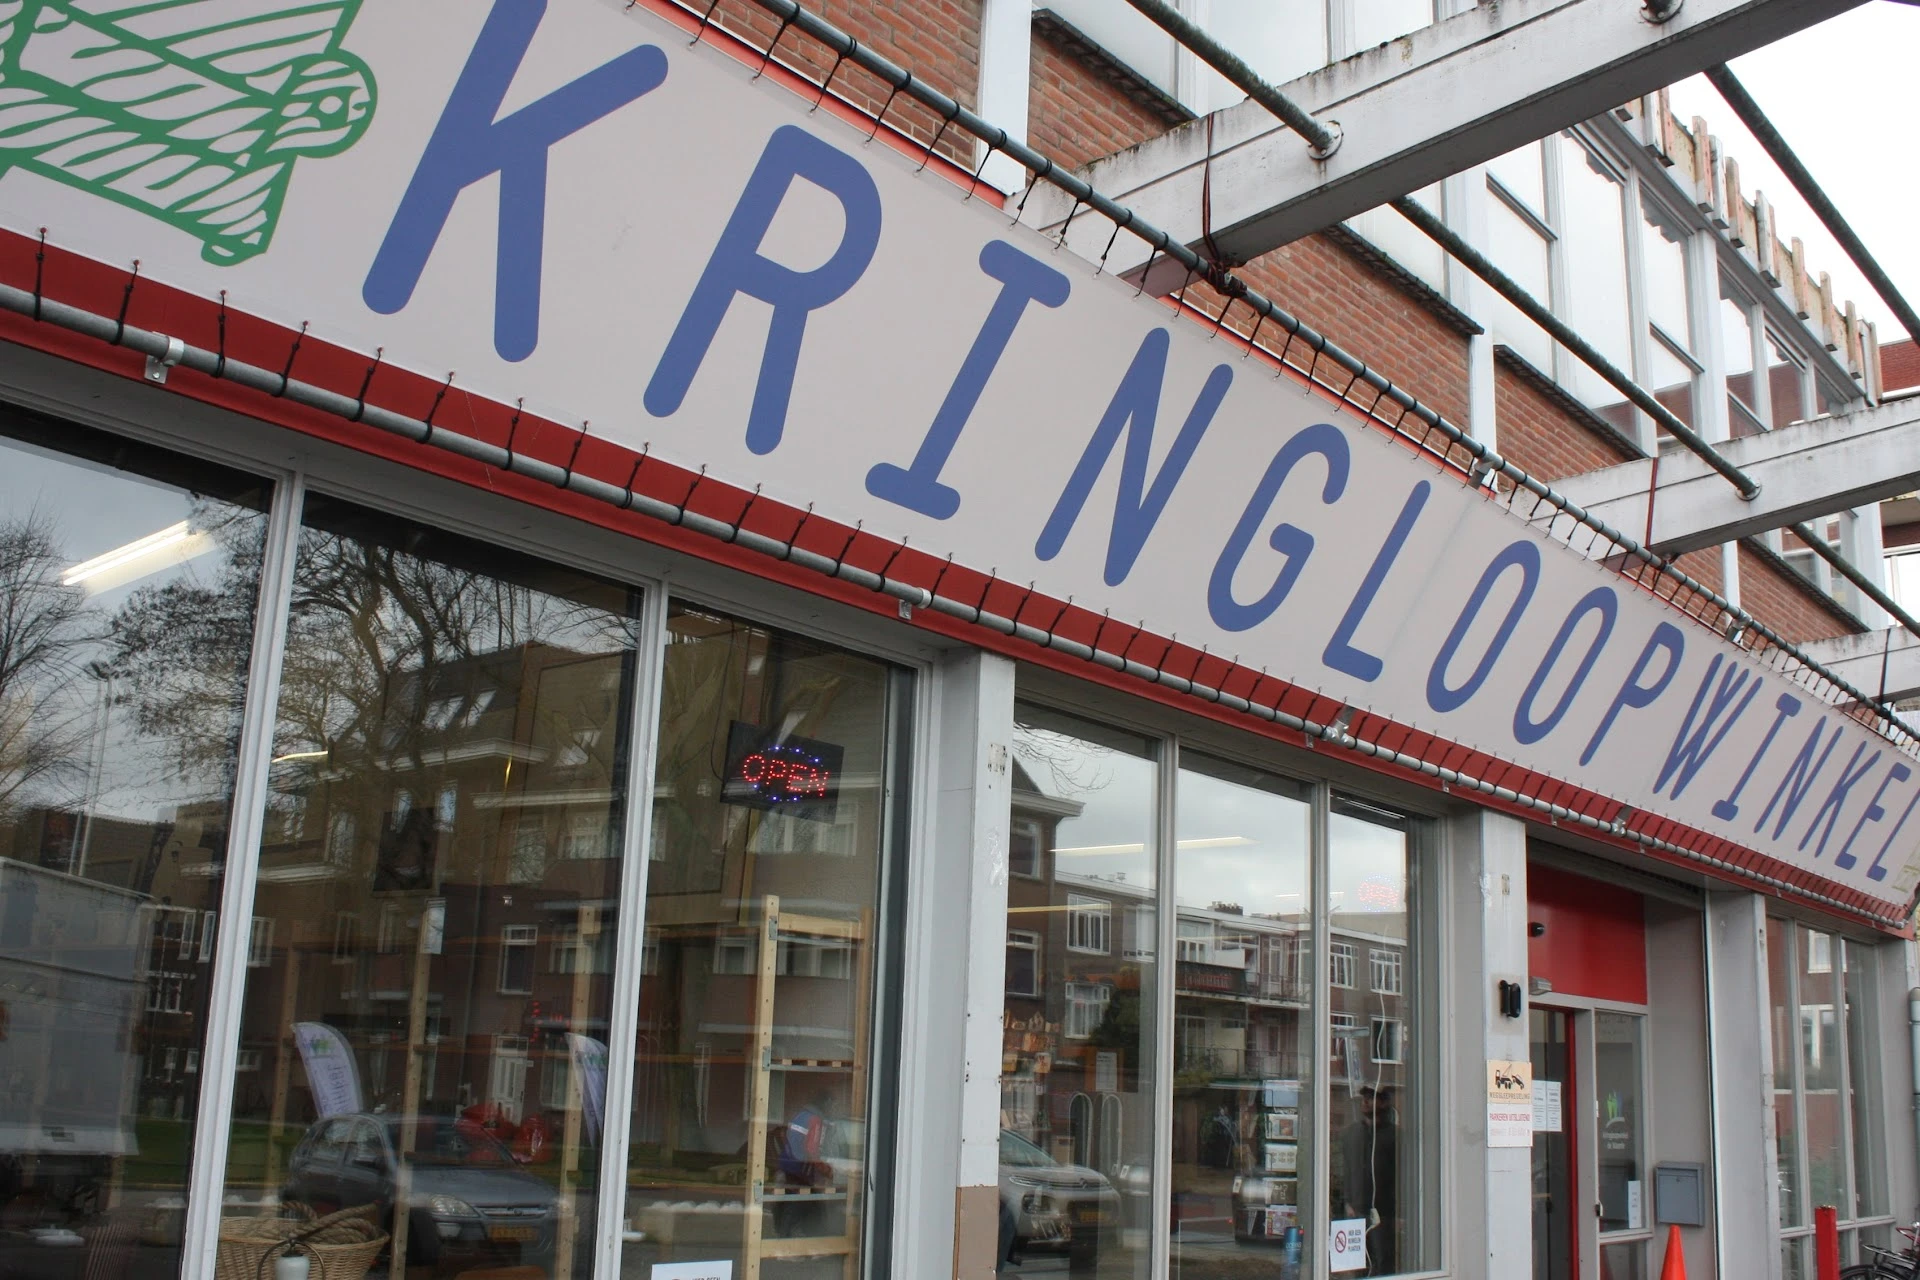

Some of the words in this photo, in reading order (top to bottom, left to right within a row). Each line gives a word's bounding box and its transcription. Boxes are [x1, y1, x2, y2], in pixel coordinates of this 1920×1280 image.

[362, 0, 1920, 882] KRINGLOOPWINKEL
[742, 754, 829, 797] OPEN
[1489, 1092, 1530, 1100] WEGSLEEPREGELING
[1489, 1113, 1508, 1121] PARKEREN
